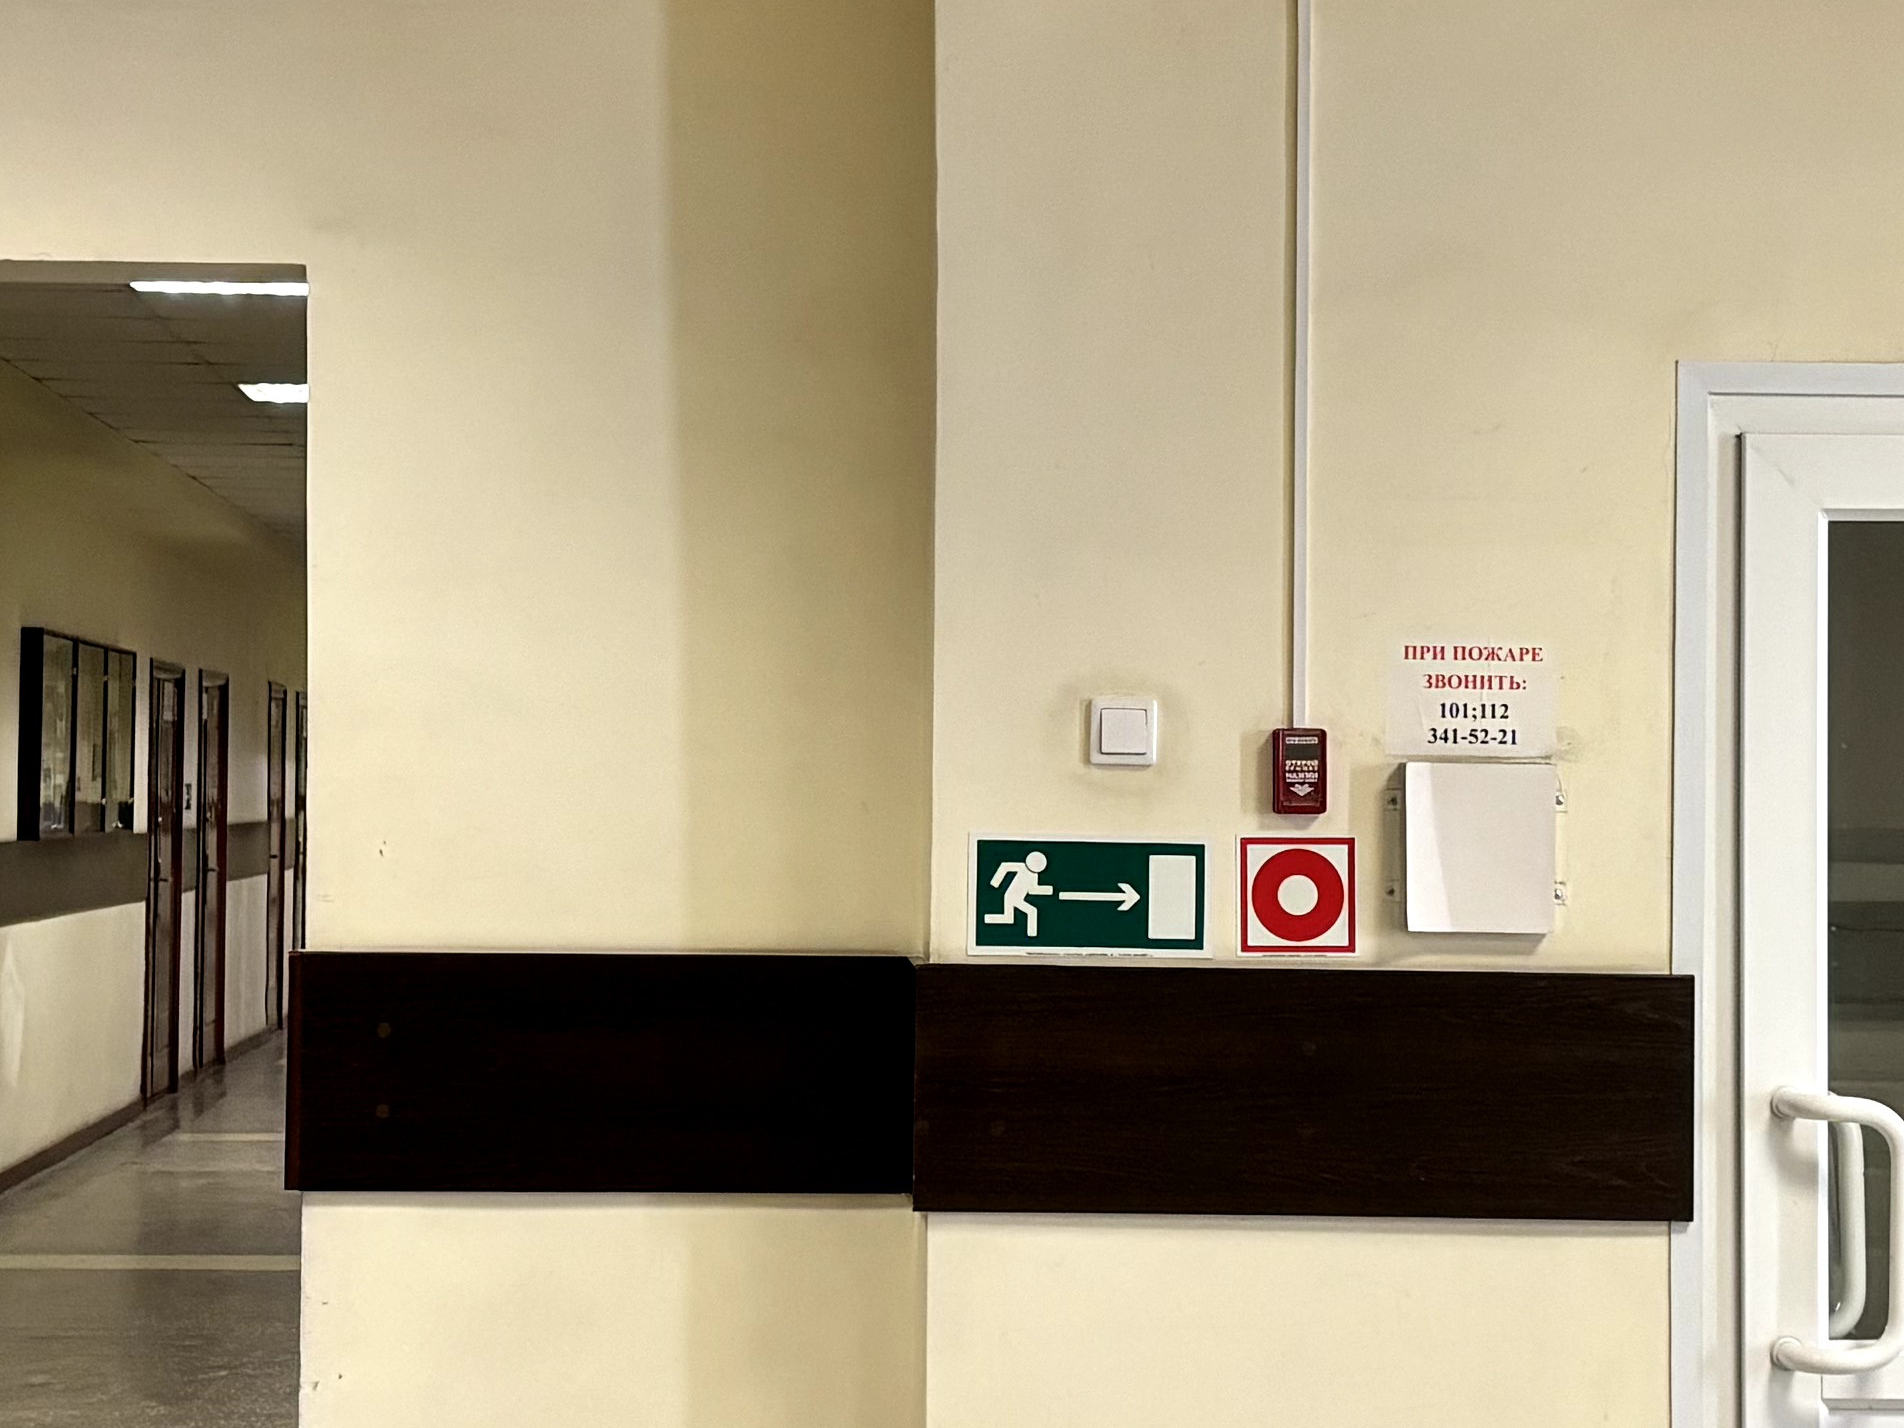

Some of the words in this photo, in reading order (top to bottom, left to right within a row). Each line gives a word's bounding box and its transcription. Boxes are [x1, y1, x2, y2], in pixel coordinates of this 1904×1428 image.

[1404, 645, 1445, 660] ПРИ
[1453, 646, 1544, 662] ПОЖАРЕ
[1423, 674, 1527, 690] ЗВОНИТЬ:
[1440, 702, 1509, 722] 101;112
[1427, 728, 1517, 745] 341-52-21
